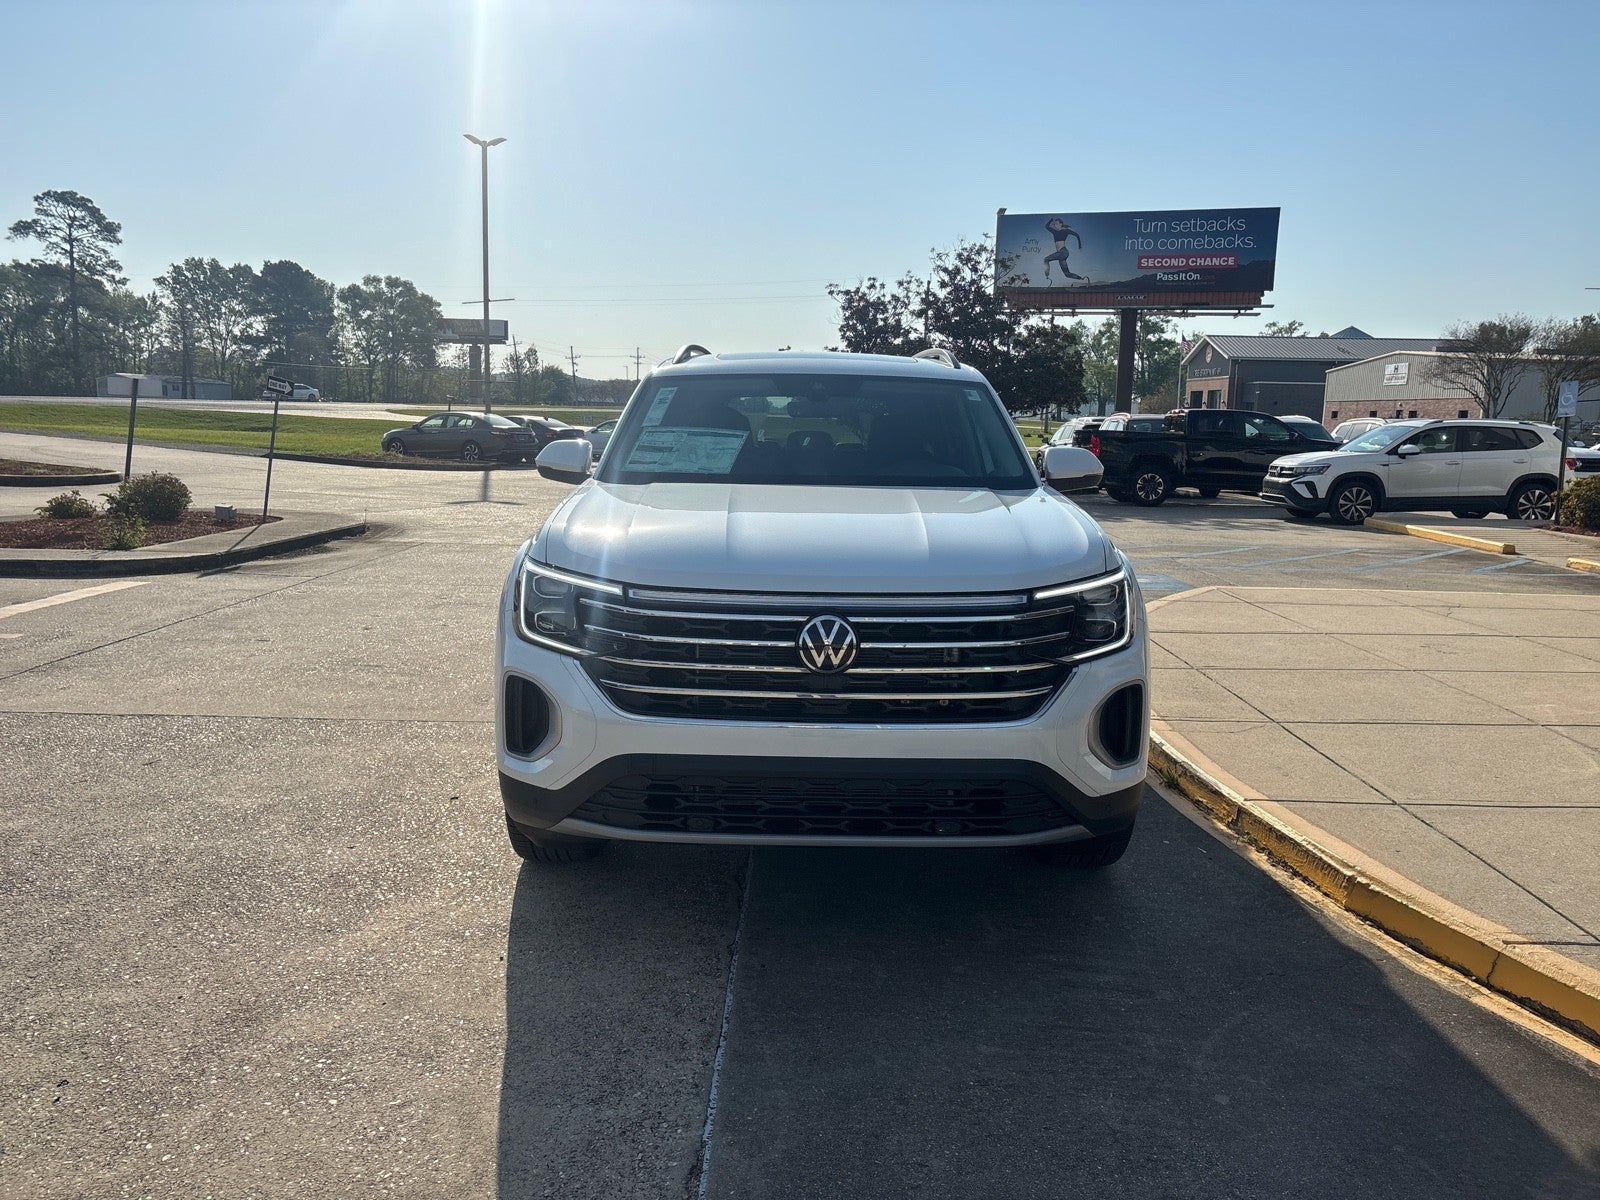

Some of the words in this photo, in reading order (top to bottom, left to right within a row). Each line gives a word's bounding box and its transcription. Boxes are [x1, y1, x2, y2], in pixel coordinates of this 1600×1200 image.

[1133, 218, 1167, 233] Turn
[1170, 216, 1246, 233] setbacks
[1125, 235, 1154, 251] into
[1157, 234, 1257, 250] comebacks.
[1140, 257, 1187, 267] SECOND
[1188, 256, 1235, 266] CHANCE
